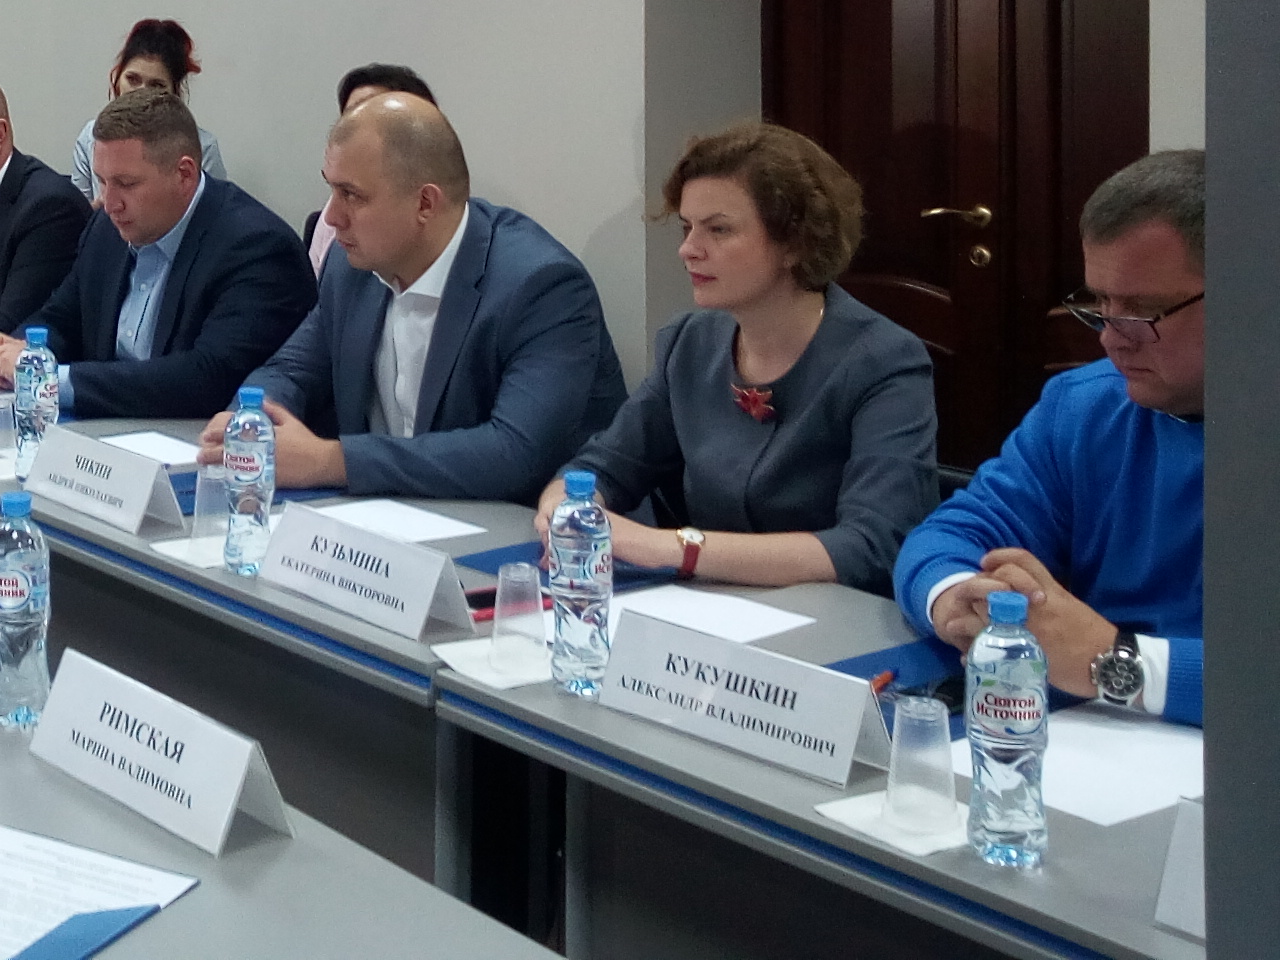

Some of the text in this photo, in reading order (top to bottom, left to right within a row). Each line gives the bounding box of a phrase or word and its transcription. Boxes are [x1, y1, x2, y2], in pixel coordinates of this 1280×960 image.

[75, 454, 113, 480] ЧИКИН
[280, 555, 406, 613] ЕКАТЕРИНА ВИКТОРОВНА
[310, 534, 391, 579] КУЗЬМИНА
[665, 652, 798, 712] КУКУШКИН
[99, 701, 185, 764] РИМСКАЯ
[617, 674, 836, 757] АЛЕКСАНДР ВЛАДИМИРОВИЧ
[69, 728, 193, 810] МАРИНА ВАДИМОВНА
